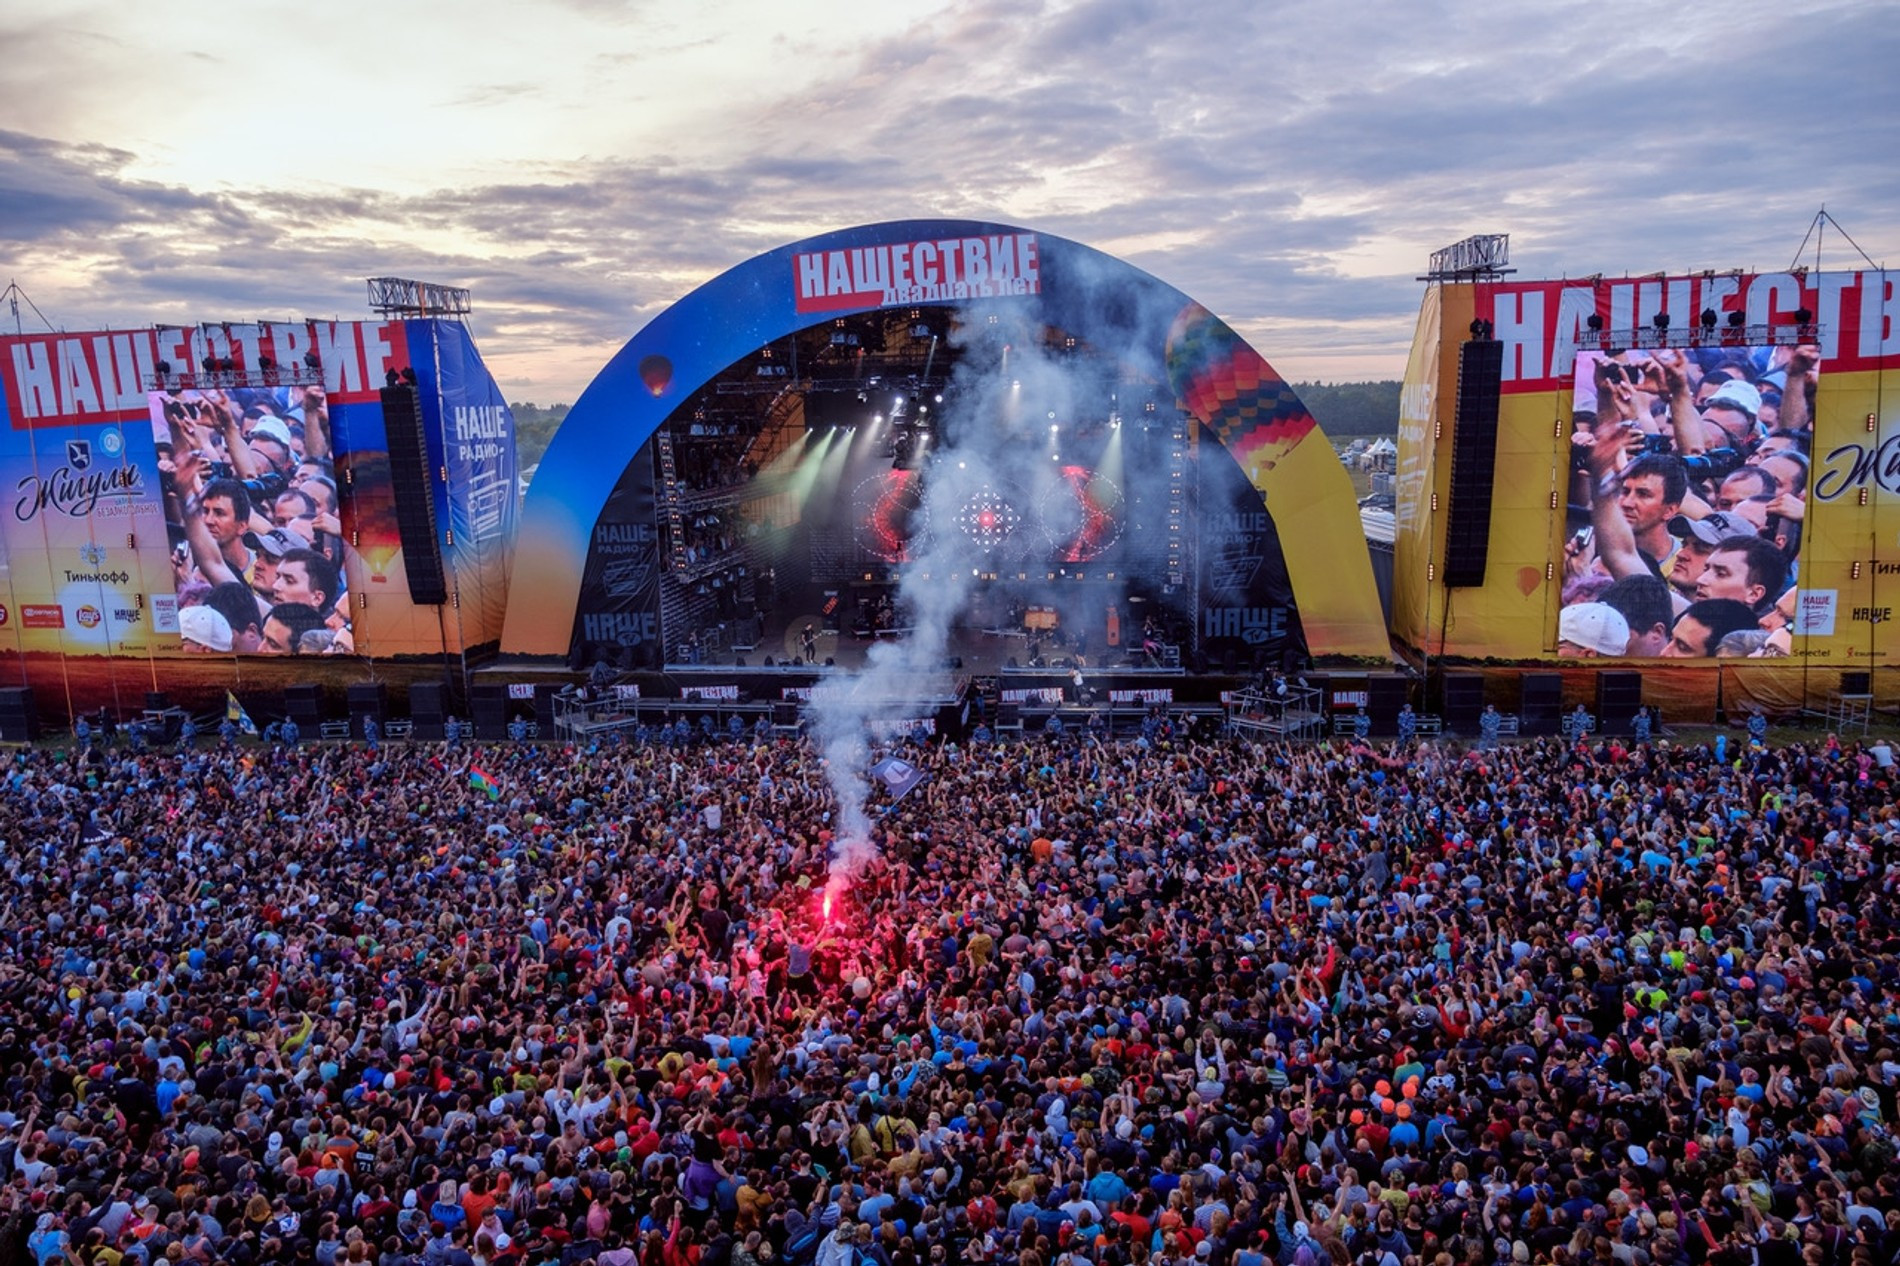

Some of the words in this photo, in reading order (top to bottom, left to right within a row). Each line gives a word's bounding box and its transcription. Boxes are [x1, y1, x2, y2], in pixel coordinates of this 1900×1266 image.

[800, 234, 1038, 298] НАШЕСТВИЕ
[11, 321, 393, 418] НАШЕСТВИЕ
[454, 405, 507, 440] НАШЕ
[459, 443, 499, 462] РАДИО
[597, 524, 650, 543] НАШЕ
[598, 544, 639, 554] РАДИО
[64, 570, 129, 584] Тинькофф
[1803, 596, 1830, 605] НАШЕ
[1205, 608, 1287, 637] НАШЕ
[1853, 607, 1892, 621] НАШЕ
[584, 612, 657, 641] НАШЕ
